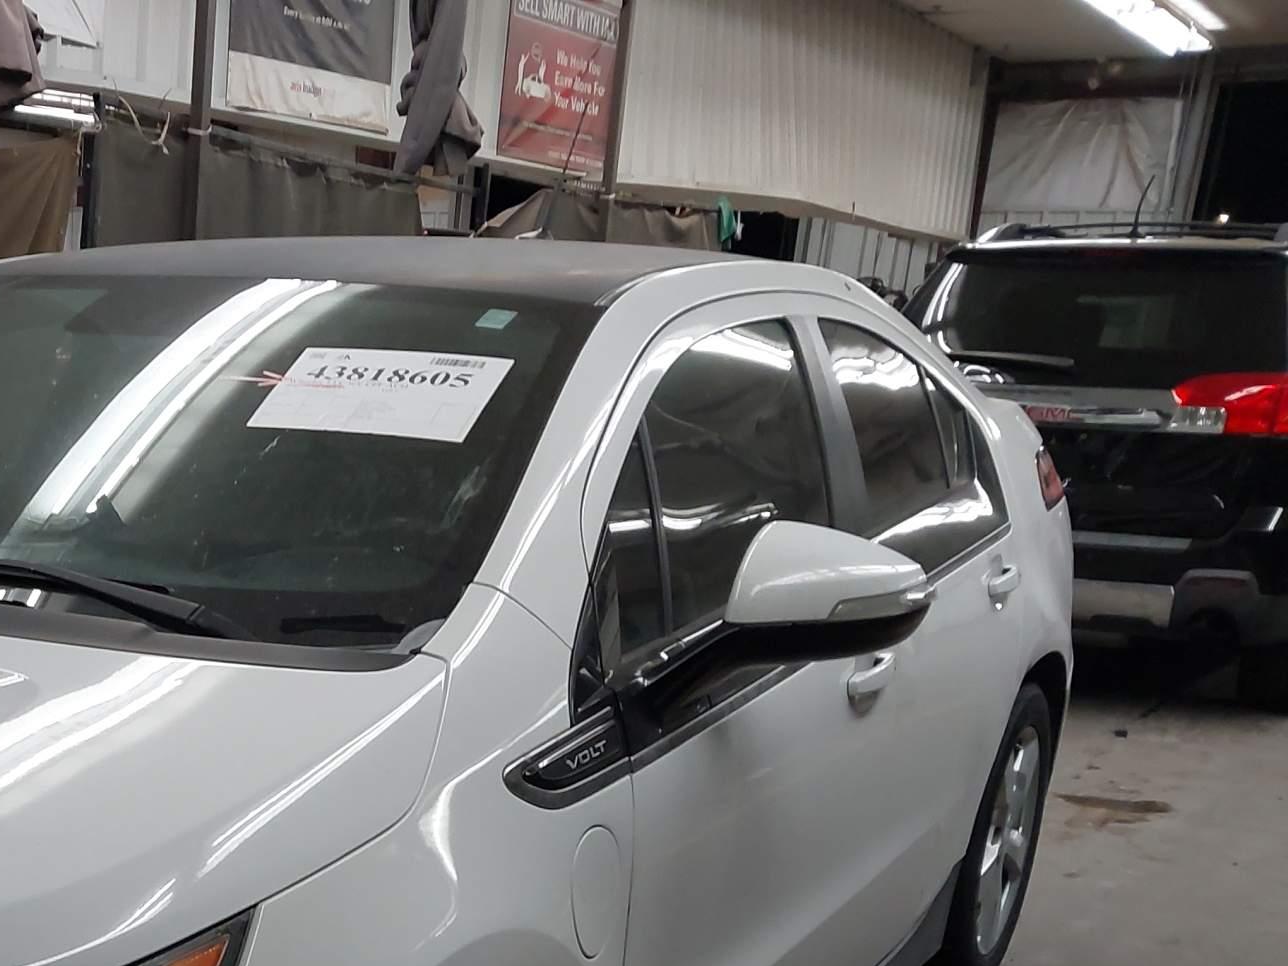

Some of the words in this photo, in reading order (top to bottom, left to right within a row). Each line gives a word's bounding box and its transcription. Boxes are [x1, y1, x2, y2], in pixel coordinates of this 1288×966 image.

[541, 0, 576, 28] SMART
[576, 7, 601, 37] WITH
[556, 48, 569, 67] We
[588, 59, 601, 77] You
[554, 91, 569, 109] Your
[307, 364, 474, 388] 43818605
[565, 739, 608, 770] VOLT
